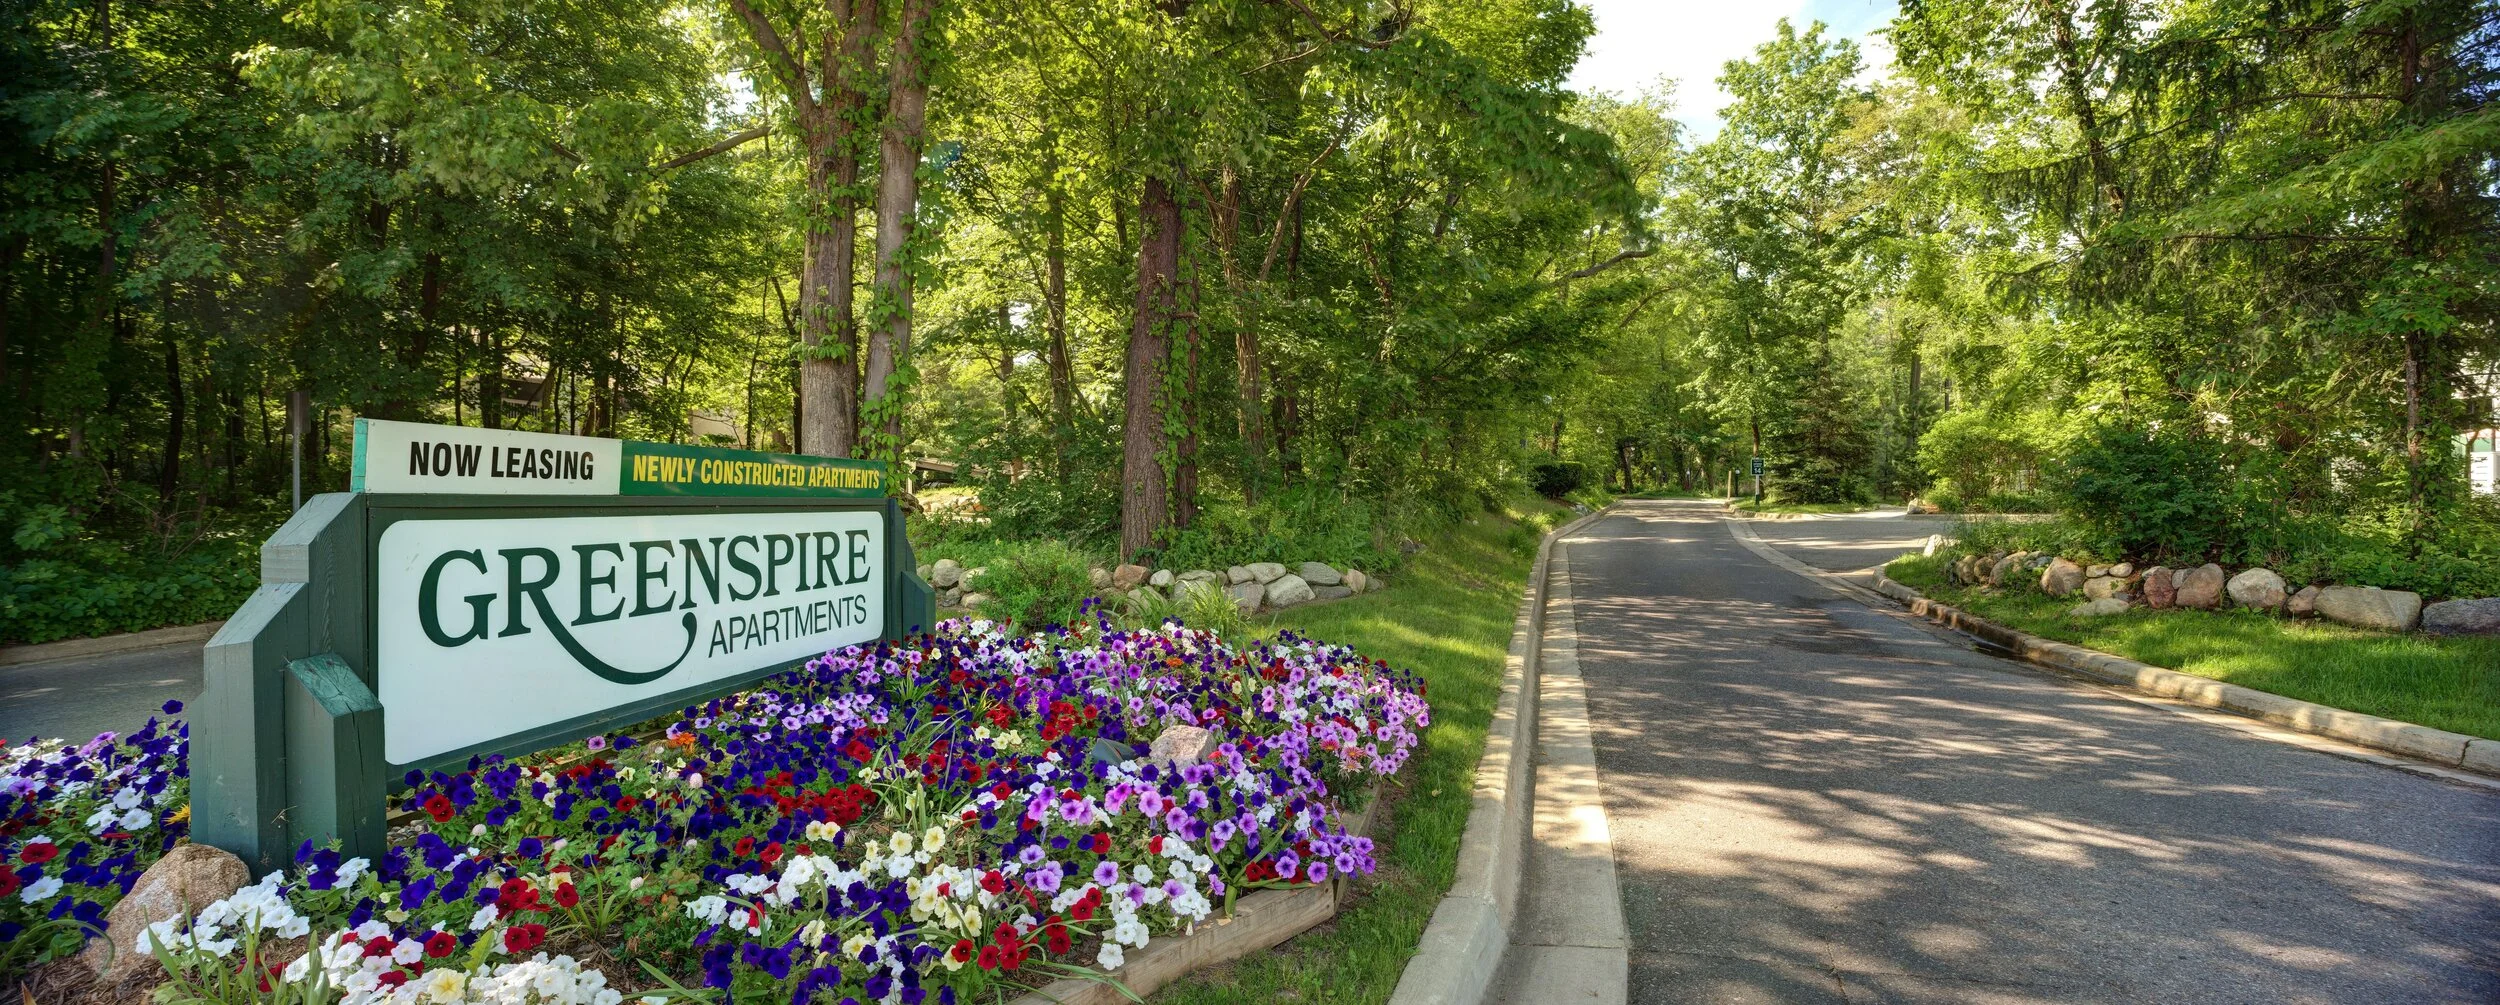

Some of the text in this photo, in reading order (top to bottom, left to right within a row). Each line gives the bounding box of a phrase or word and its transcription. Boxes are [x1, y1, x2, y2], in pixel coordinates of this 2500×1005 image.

[409, 441, 594, 480] NOW LEASING
[633, 455, 880, 489] NEWLY CONSTRUCTED APARTMENTS
[418, 529, 871, 685] GREENSPIRE
[708, 594, 867, 659] APARTMENTS
